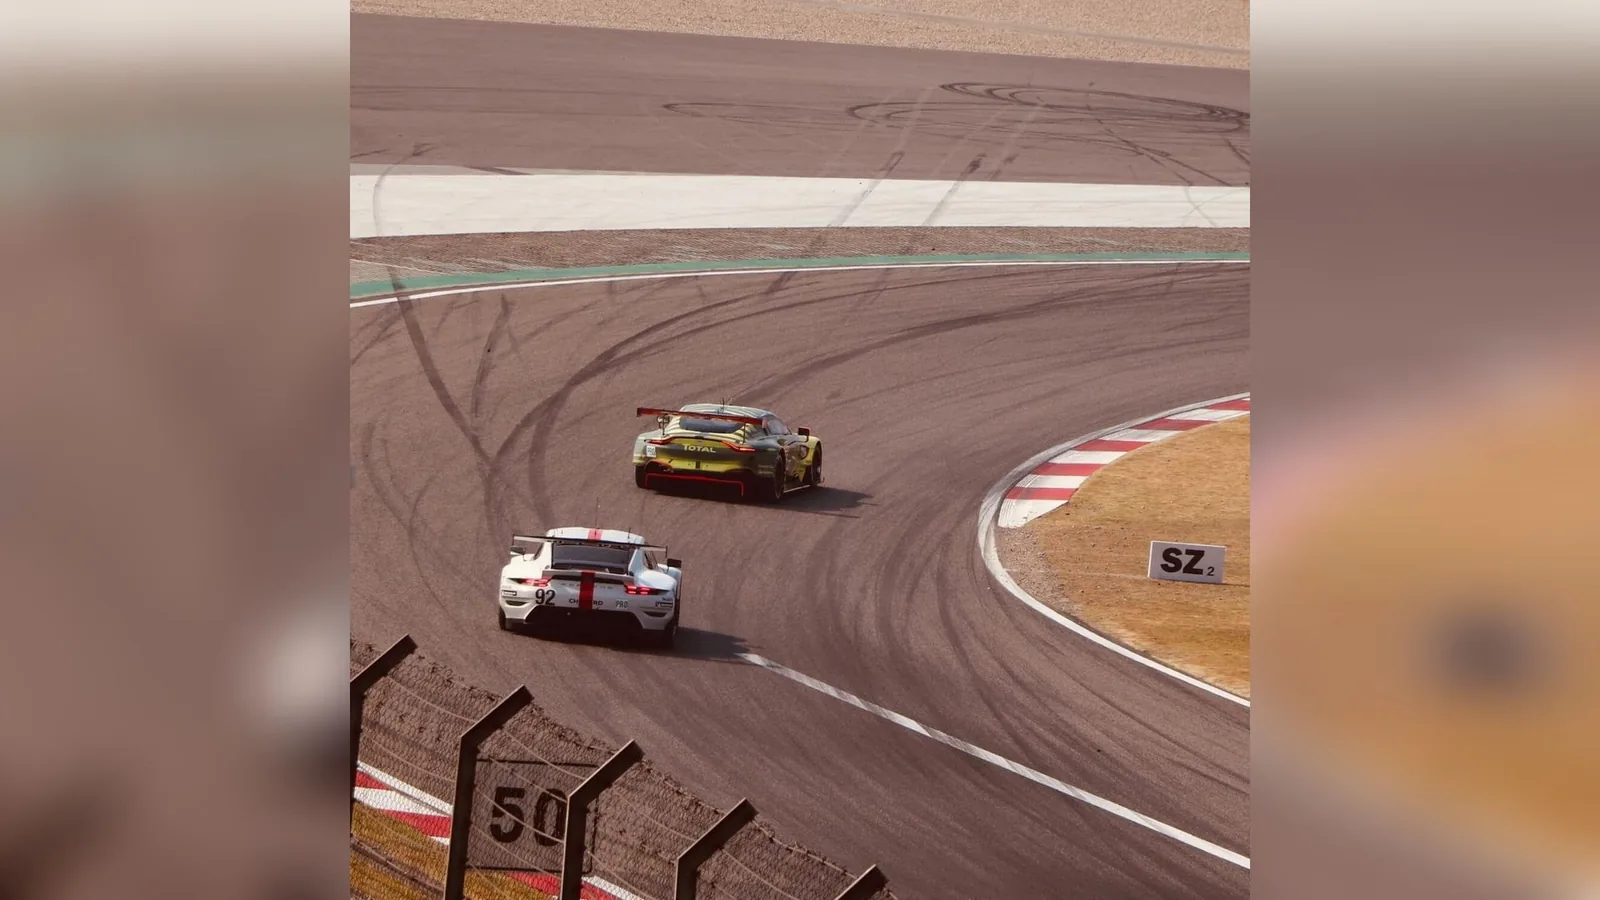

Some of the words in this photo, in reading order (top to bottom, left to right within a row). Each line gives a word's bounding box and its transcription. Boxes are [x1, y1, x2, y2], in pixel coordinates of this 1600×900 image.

[682, 443, 717, 454] TOTAL
[535, 588, 556, 606] 92
[615, 600, 629, 609] PRO
[490, 787, 568, 846] 50
